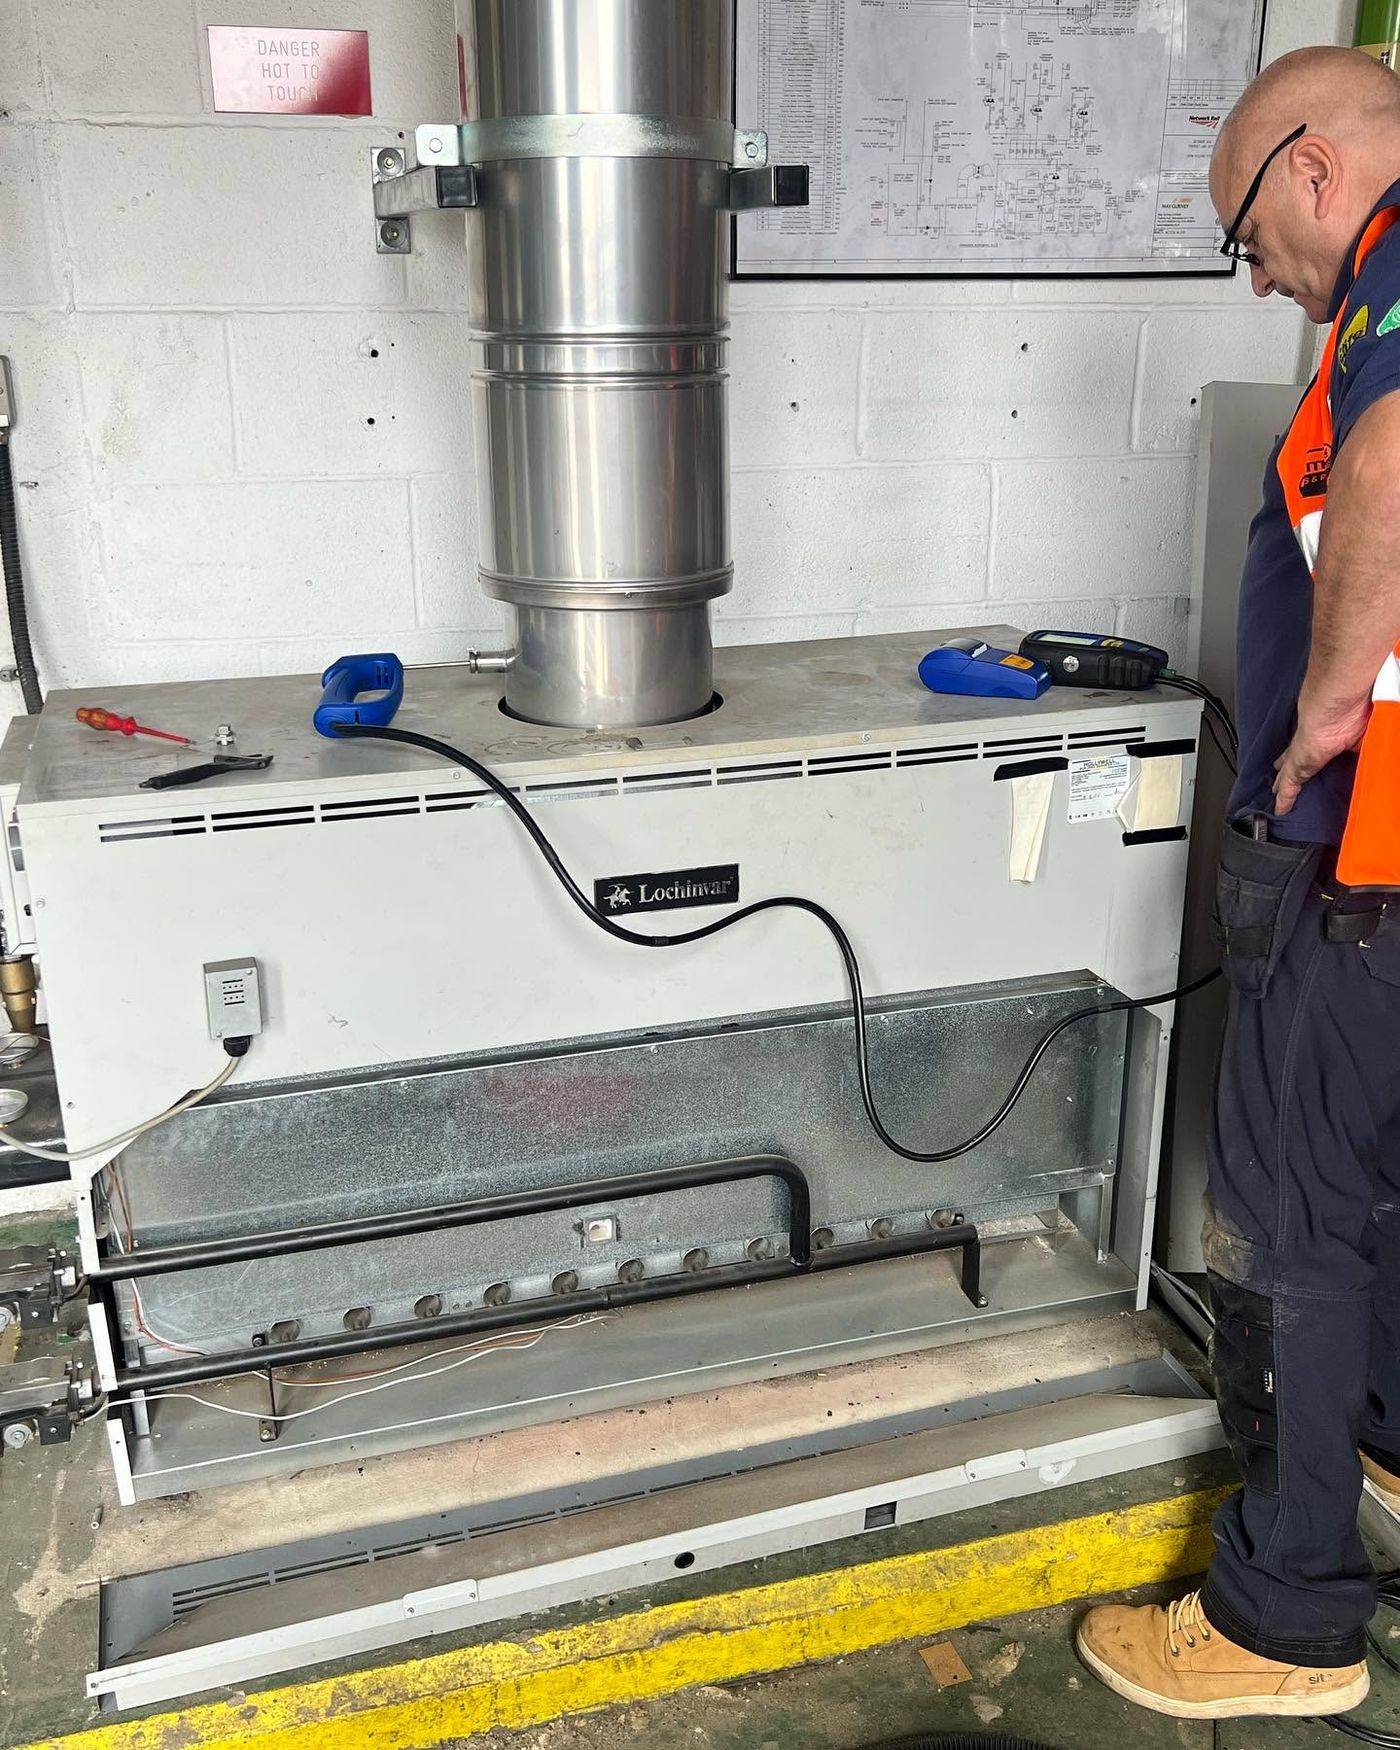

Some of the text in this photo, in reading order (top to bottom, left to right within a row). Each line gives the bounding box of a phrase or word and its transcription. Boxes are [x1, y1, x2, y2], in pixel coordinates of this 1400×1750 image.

[257, 39, 320, 57] DANGER
[261, 62, 319, 80] HOT TO
[266, 85, 319, 102] TOUCH
[638, 879, 731, 904] Lochinvar
